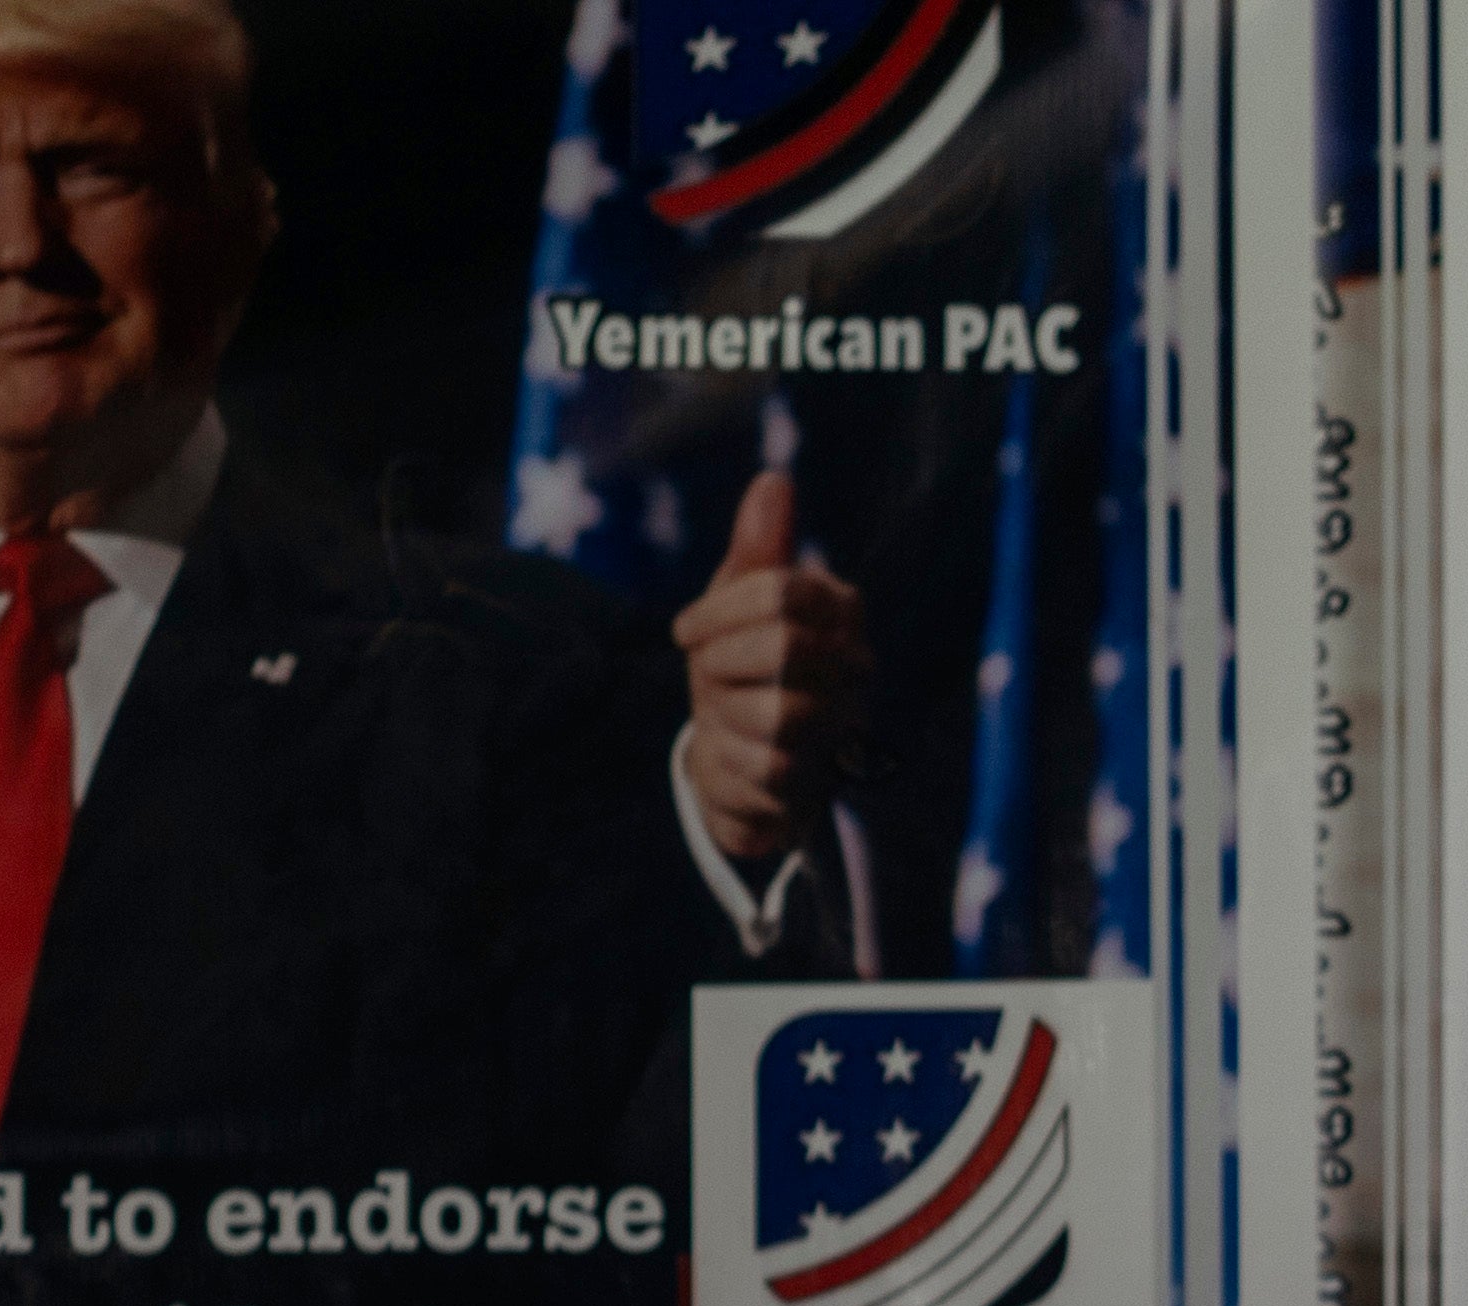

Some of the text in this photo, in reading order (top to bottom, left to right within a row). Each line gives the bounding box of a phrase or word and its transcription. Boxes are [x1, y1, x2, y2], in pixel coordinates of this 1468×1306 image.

[550, 296, 1080, 374] Yemerican PAC
[64, 1174, 176, 1255] to
[206, 1170, 664, 1255] endorse
